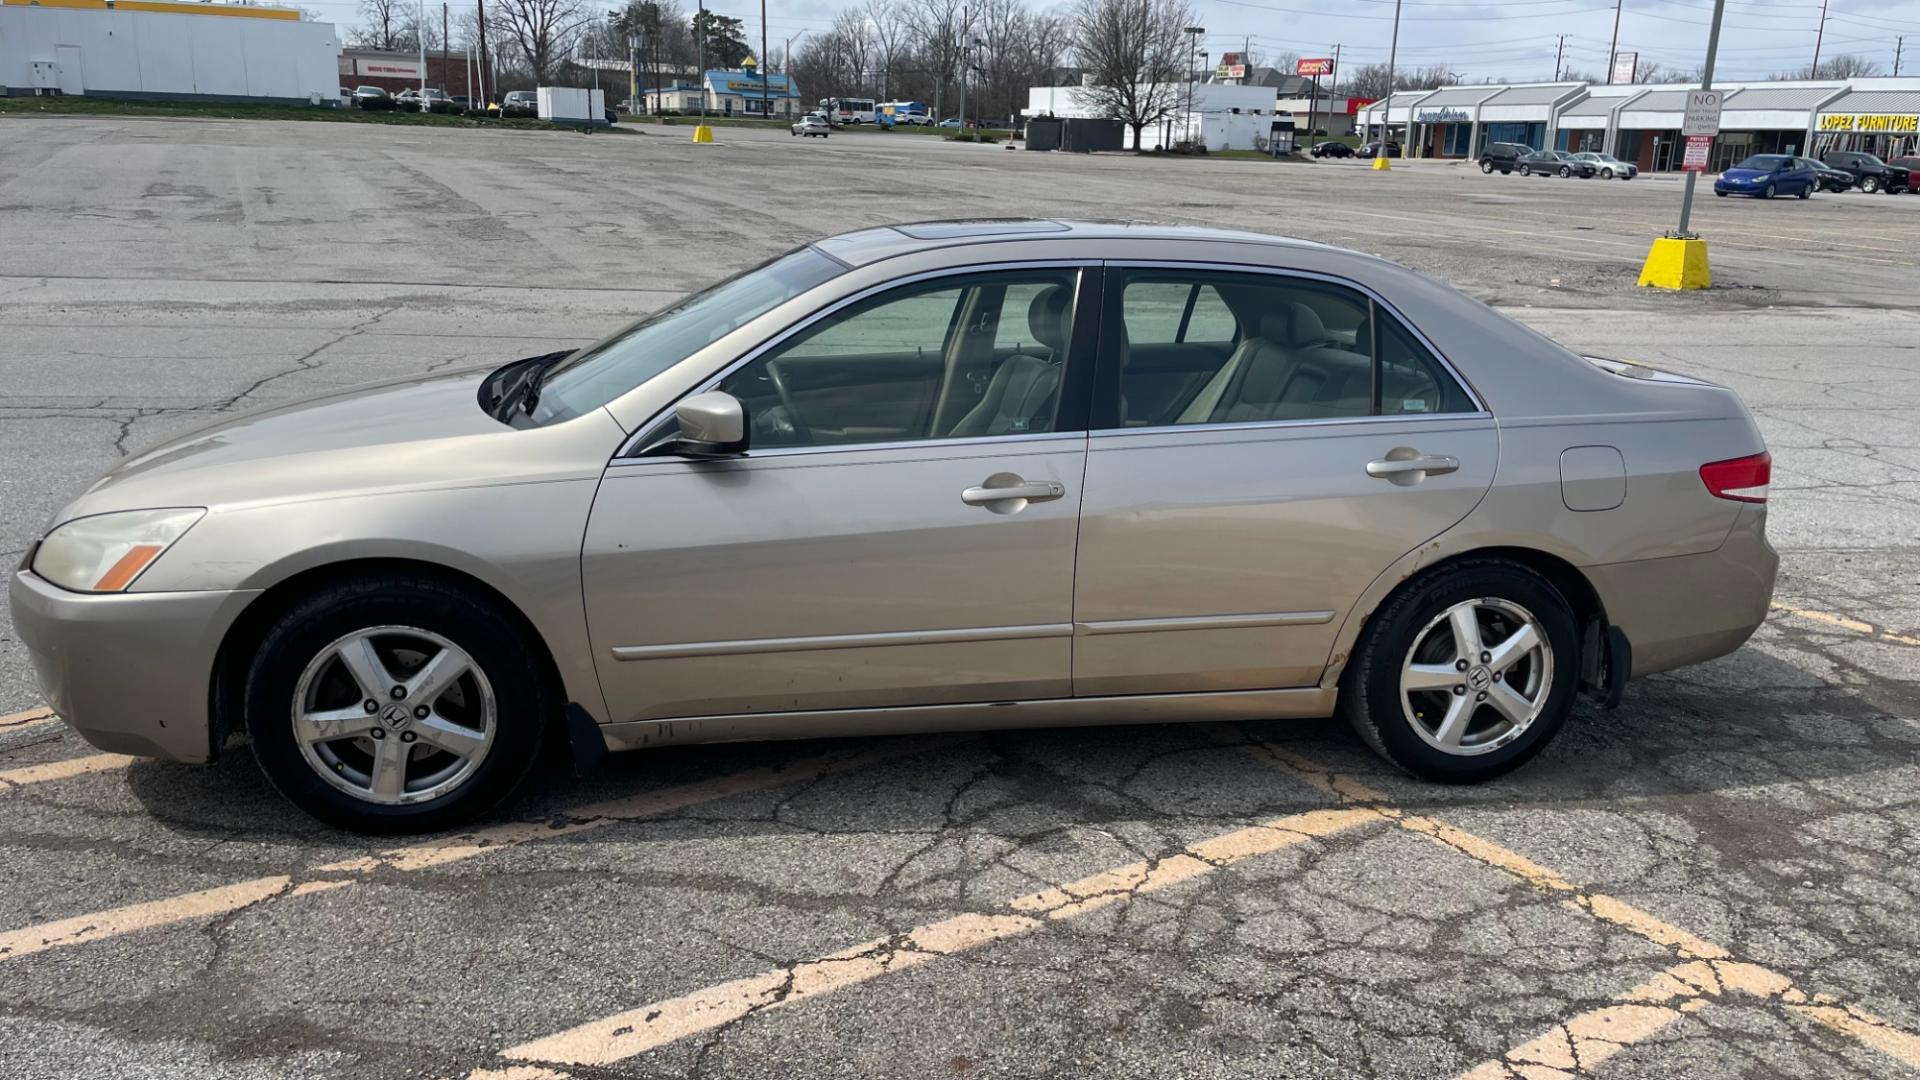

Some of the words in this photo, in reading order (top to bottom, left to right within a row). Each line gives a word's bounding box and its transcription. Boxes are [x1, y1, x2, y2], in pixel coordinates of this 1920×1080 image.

[1694, 94, 1716, 105] NO
[1820, 115, 1855, 130] LOPEZ
[1856, 115, 1919, 131] FURNITURE
